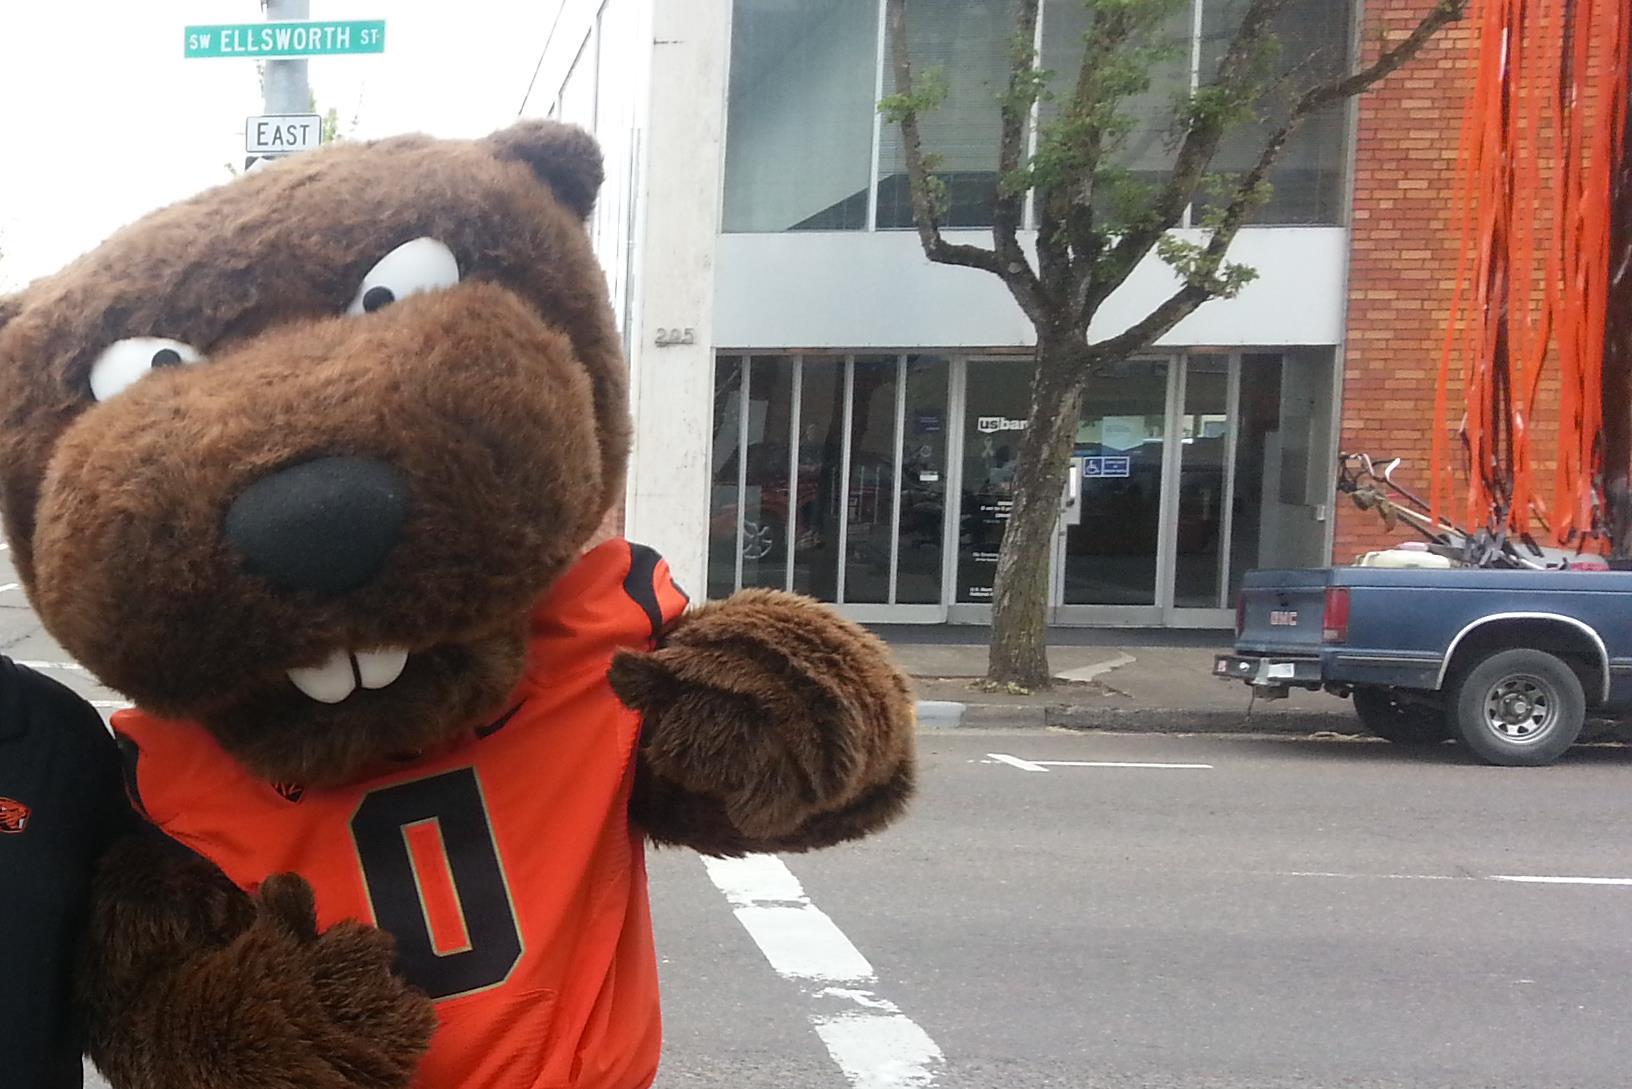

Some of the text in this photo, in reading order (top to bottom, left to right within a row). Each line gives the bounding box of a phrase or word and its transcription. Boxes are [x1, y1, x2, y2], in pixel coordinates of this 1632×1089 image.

[189, 26, 380, 53] SW ELLSWORTH ST
[256, 122, 311, 147] EAST
